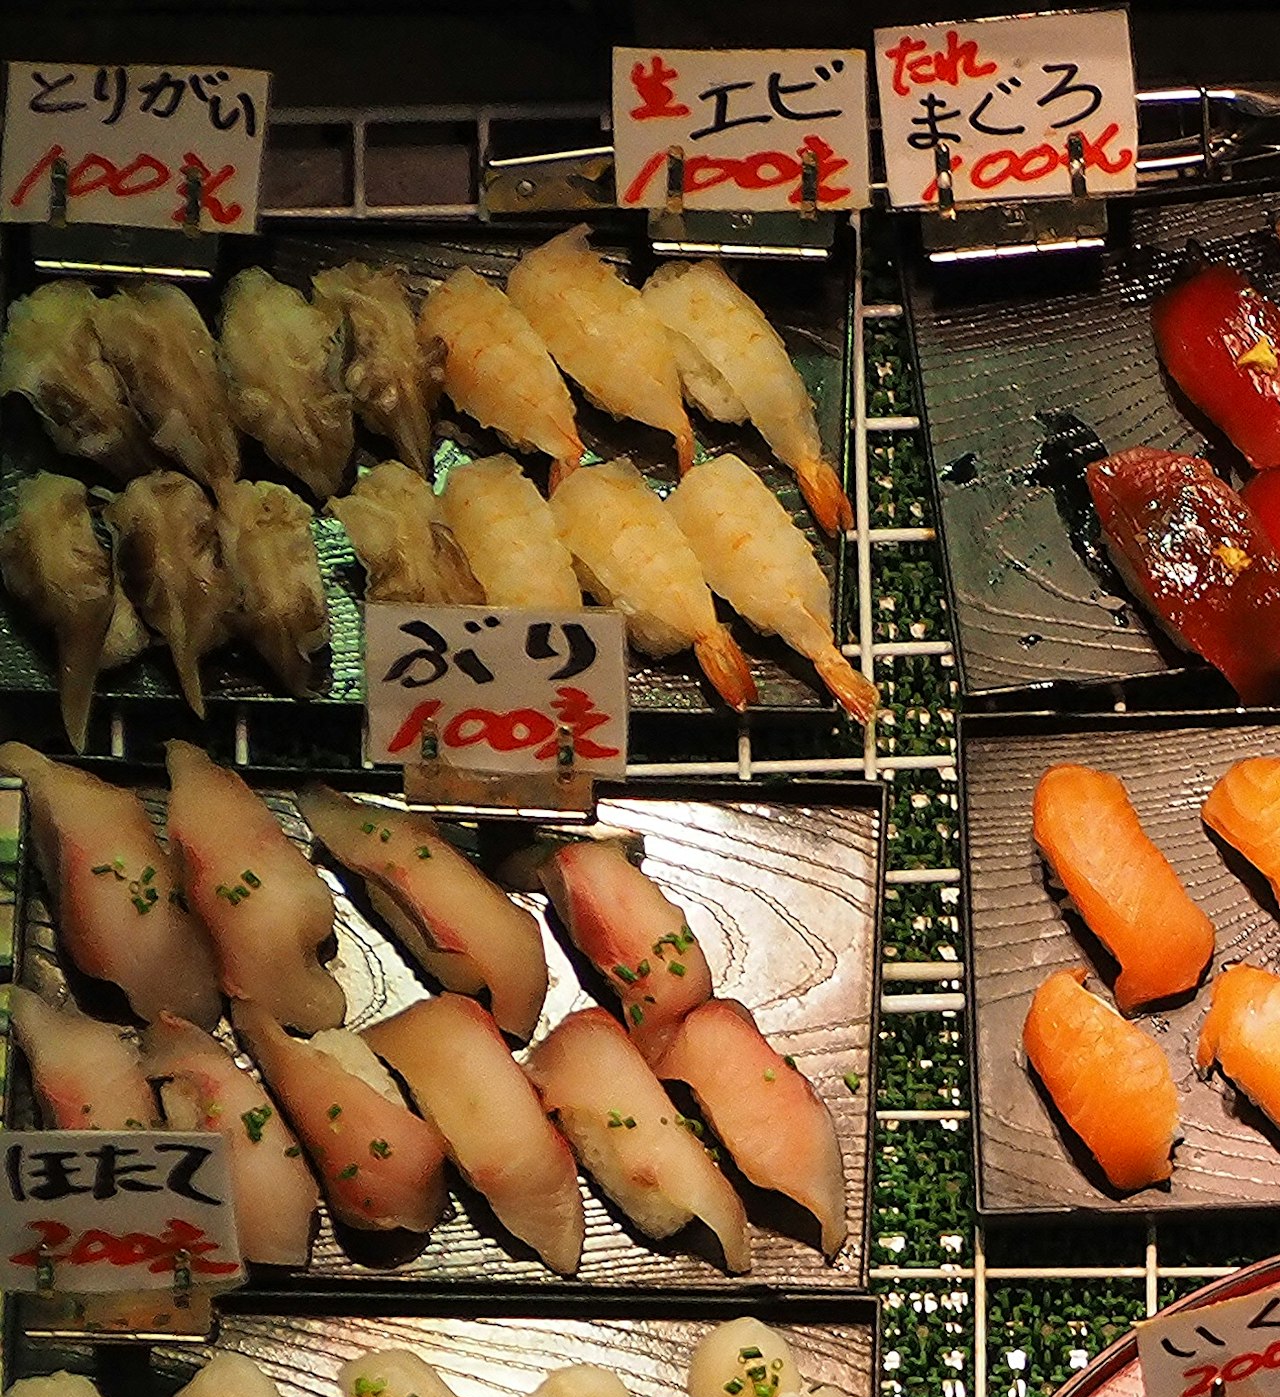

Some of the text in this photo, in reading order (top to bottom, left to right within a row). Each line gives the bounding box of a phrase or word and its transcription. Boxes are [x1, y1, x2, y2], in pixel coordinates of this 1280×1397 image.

[629, 56, 845, 140] 生エビ
[885, 30, 998, 96] たれ
[29, 66, 256, 137] とりがい
[906, 64, 1103, 149] まぐろ
[381, 616, 597, 688] ぶり
[6, 1142, 222, 1206] ほたて
